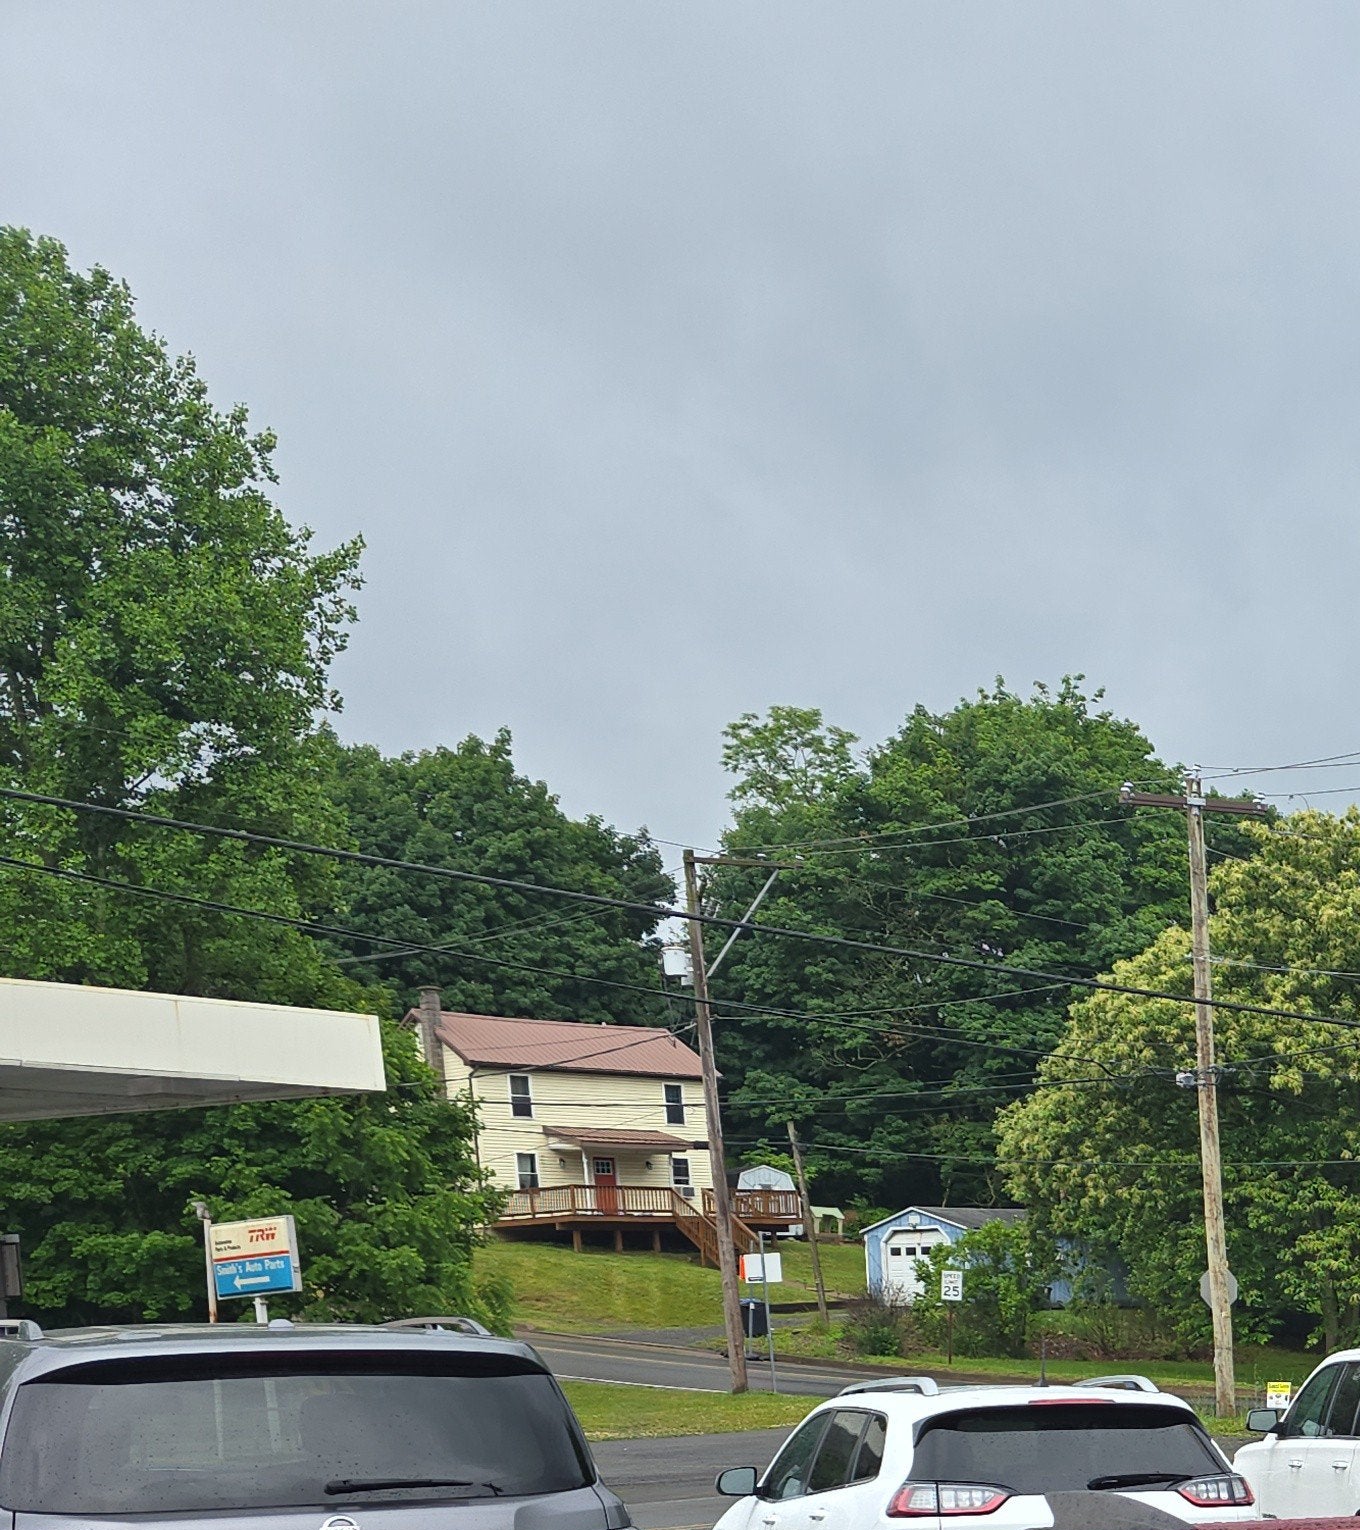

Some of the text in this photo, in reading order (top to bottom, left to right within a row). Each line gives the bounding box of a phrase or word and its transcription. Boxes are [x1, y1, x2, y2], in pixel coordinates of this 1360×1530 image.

[246, 1261, 262, 1273] Auto
[265, 1259, 284, 1270] Parts
[943, 1286, 960, 1297] 25
